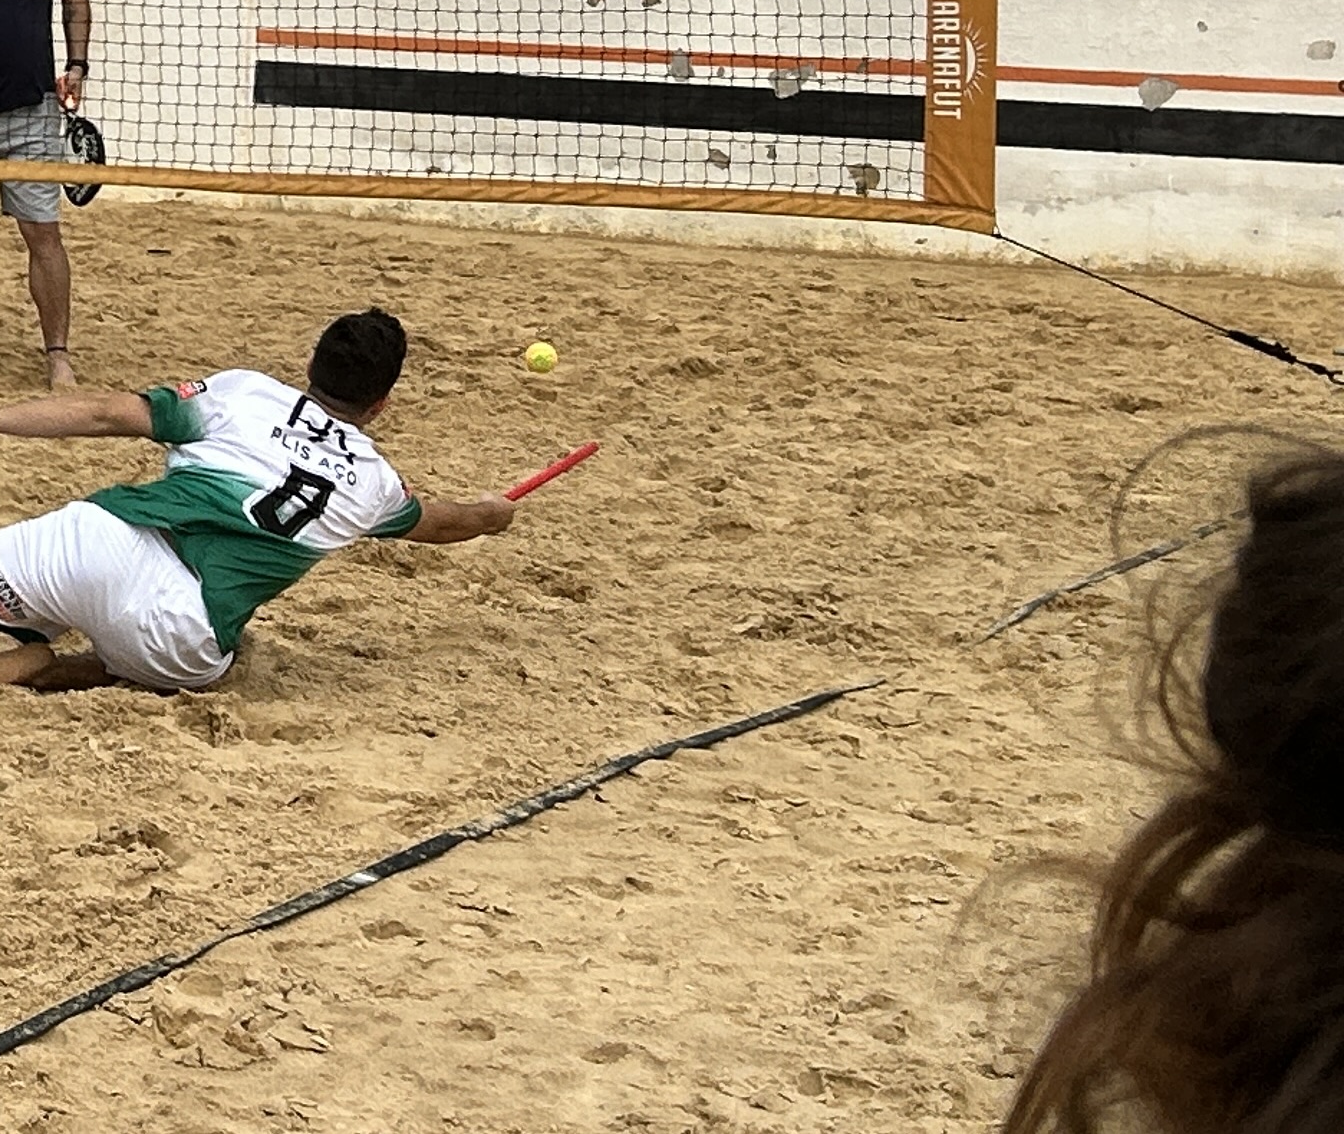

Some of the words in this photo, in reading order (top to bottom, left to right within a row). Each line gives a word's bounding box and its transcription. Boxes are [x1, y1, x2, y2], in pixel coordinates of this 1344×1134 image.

[932, 1, 961, 120] ARENAFUT
[271, 426, 311, 460] PLIS
[318, 457, 357, 486] AÇO
